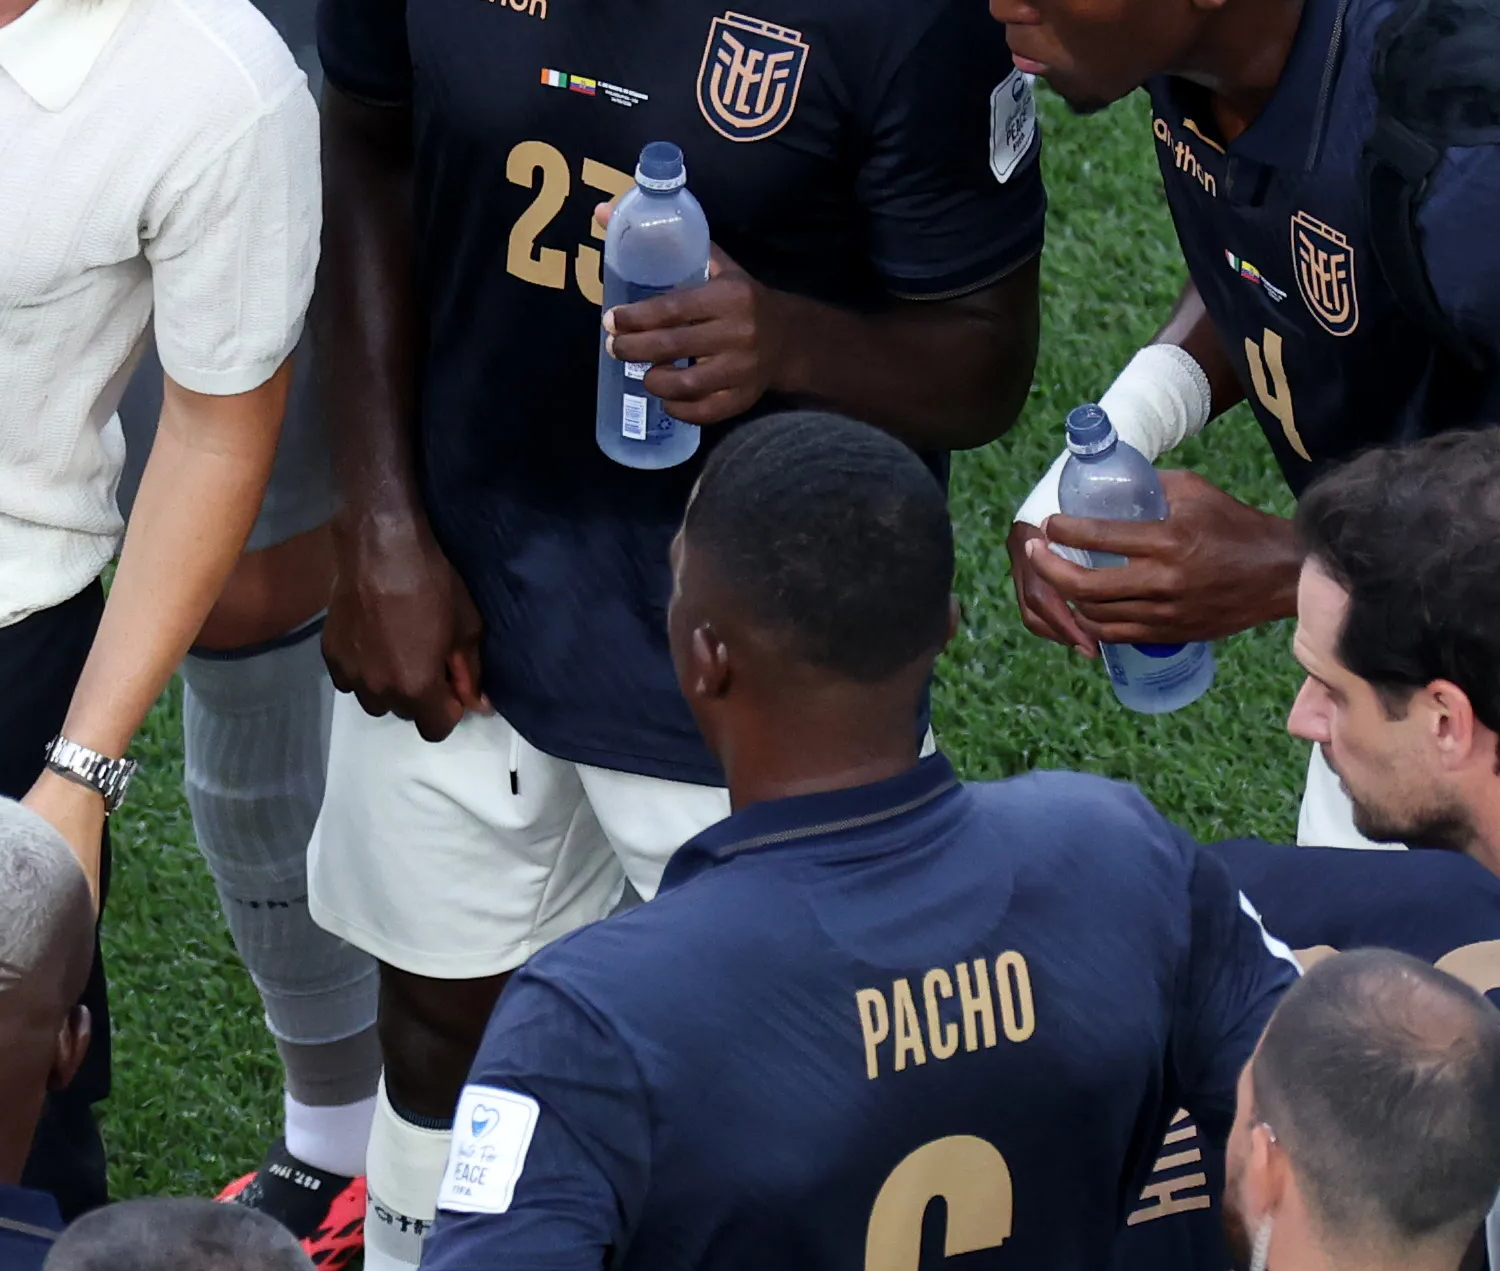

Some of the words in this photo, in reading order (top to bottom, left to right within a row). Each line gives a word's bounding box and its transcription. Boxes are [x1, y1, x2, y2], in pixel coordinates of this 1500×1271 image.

[1244, 327, 1313, 463] 4
[855, 949, 1036, 1080] PACHO
[454, 1161, 488, 1186] EACE
